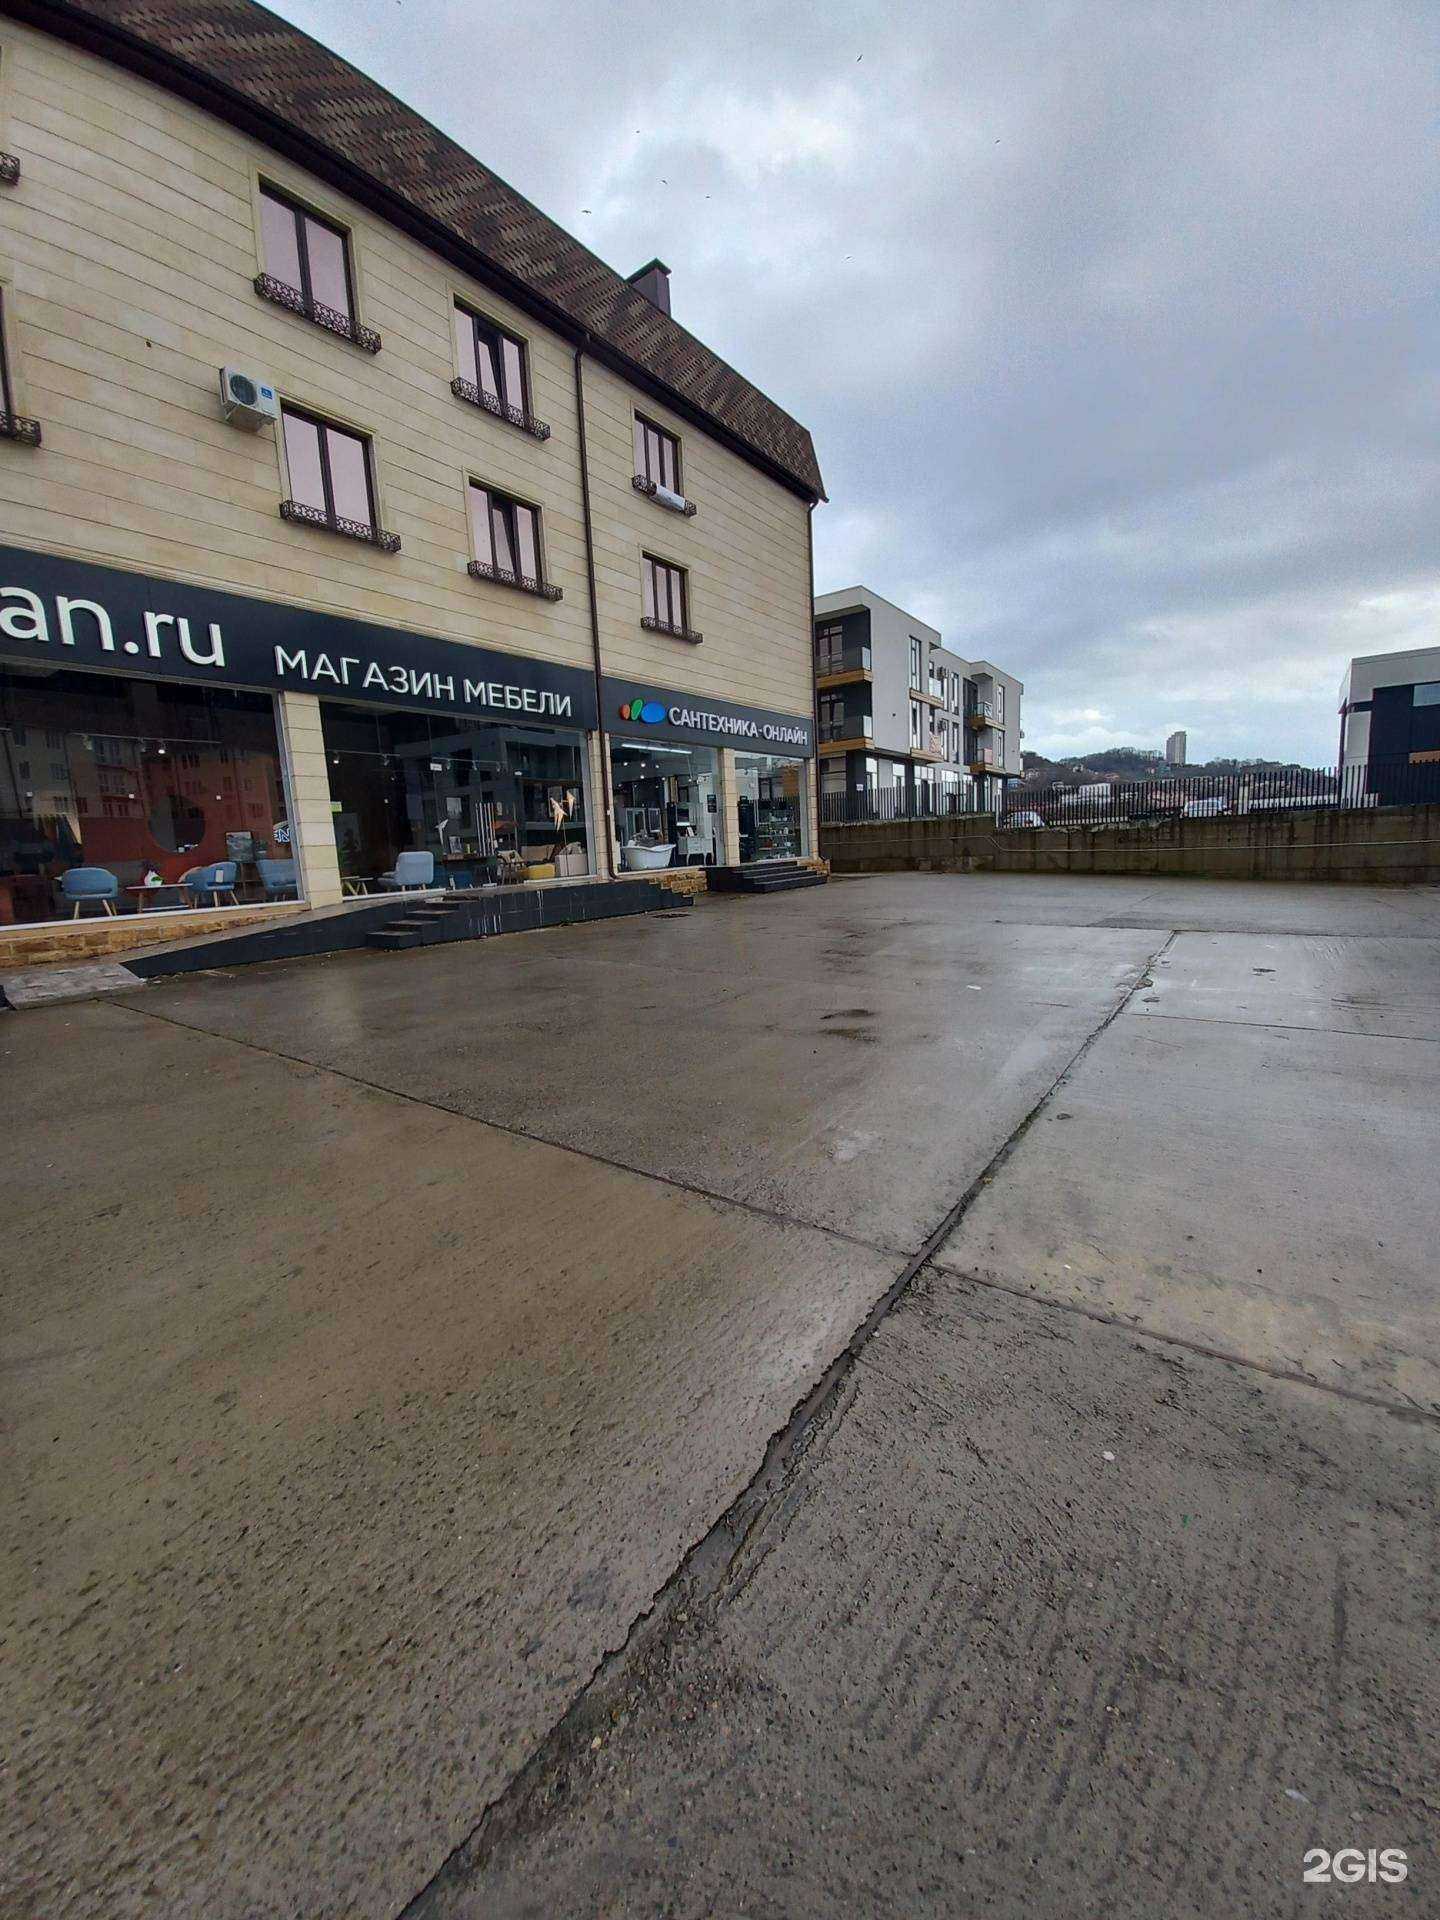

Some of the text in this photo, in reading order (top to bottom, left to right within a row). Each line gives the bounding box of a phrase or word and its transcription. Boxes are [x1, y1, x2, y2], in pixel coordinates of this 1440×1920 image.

[0, 586, 226, 668] an.ru
[274, 645, 571, 717] МАГАЗИН МЕБЕЛИ
[668, 707, 808, 745] САНТЕХНИКА-ОНЛАЙН
